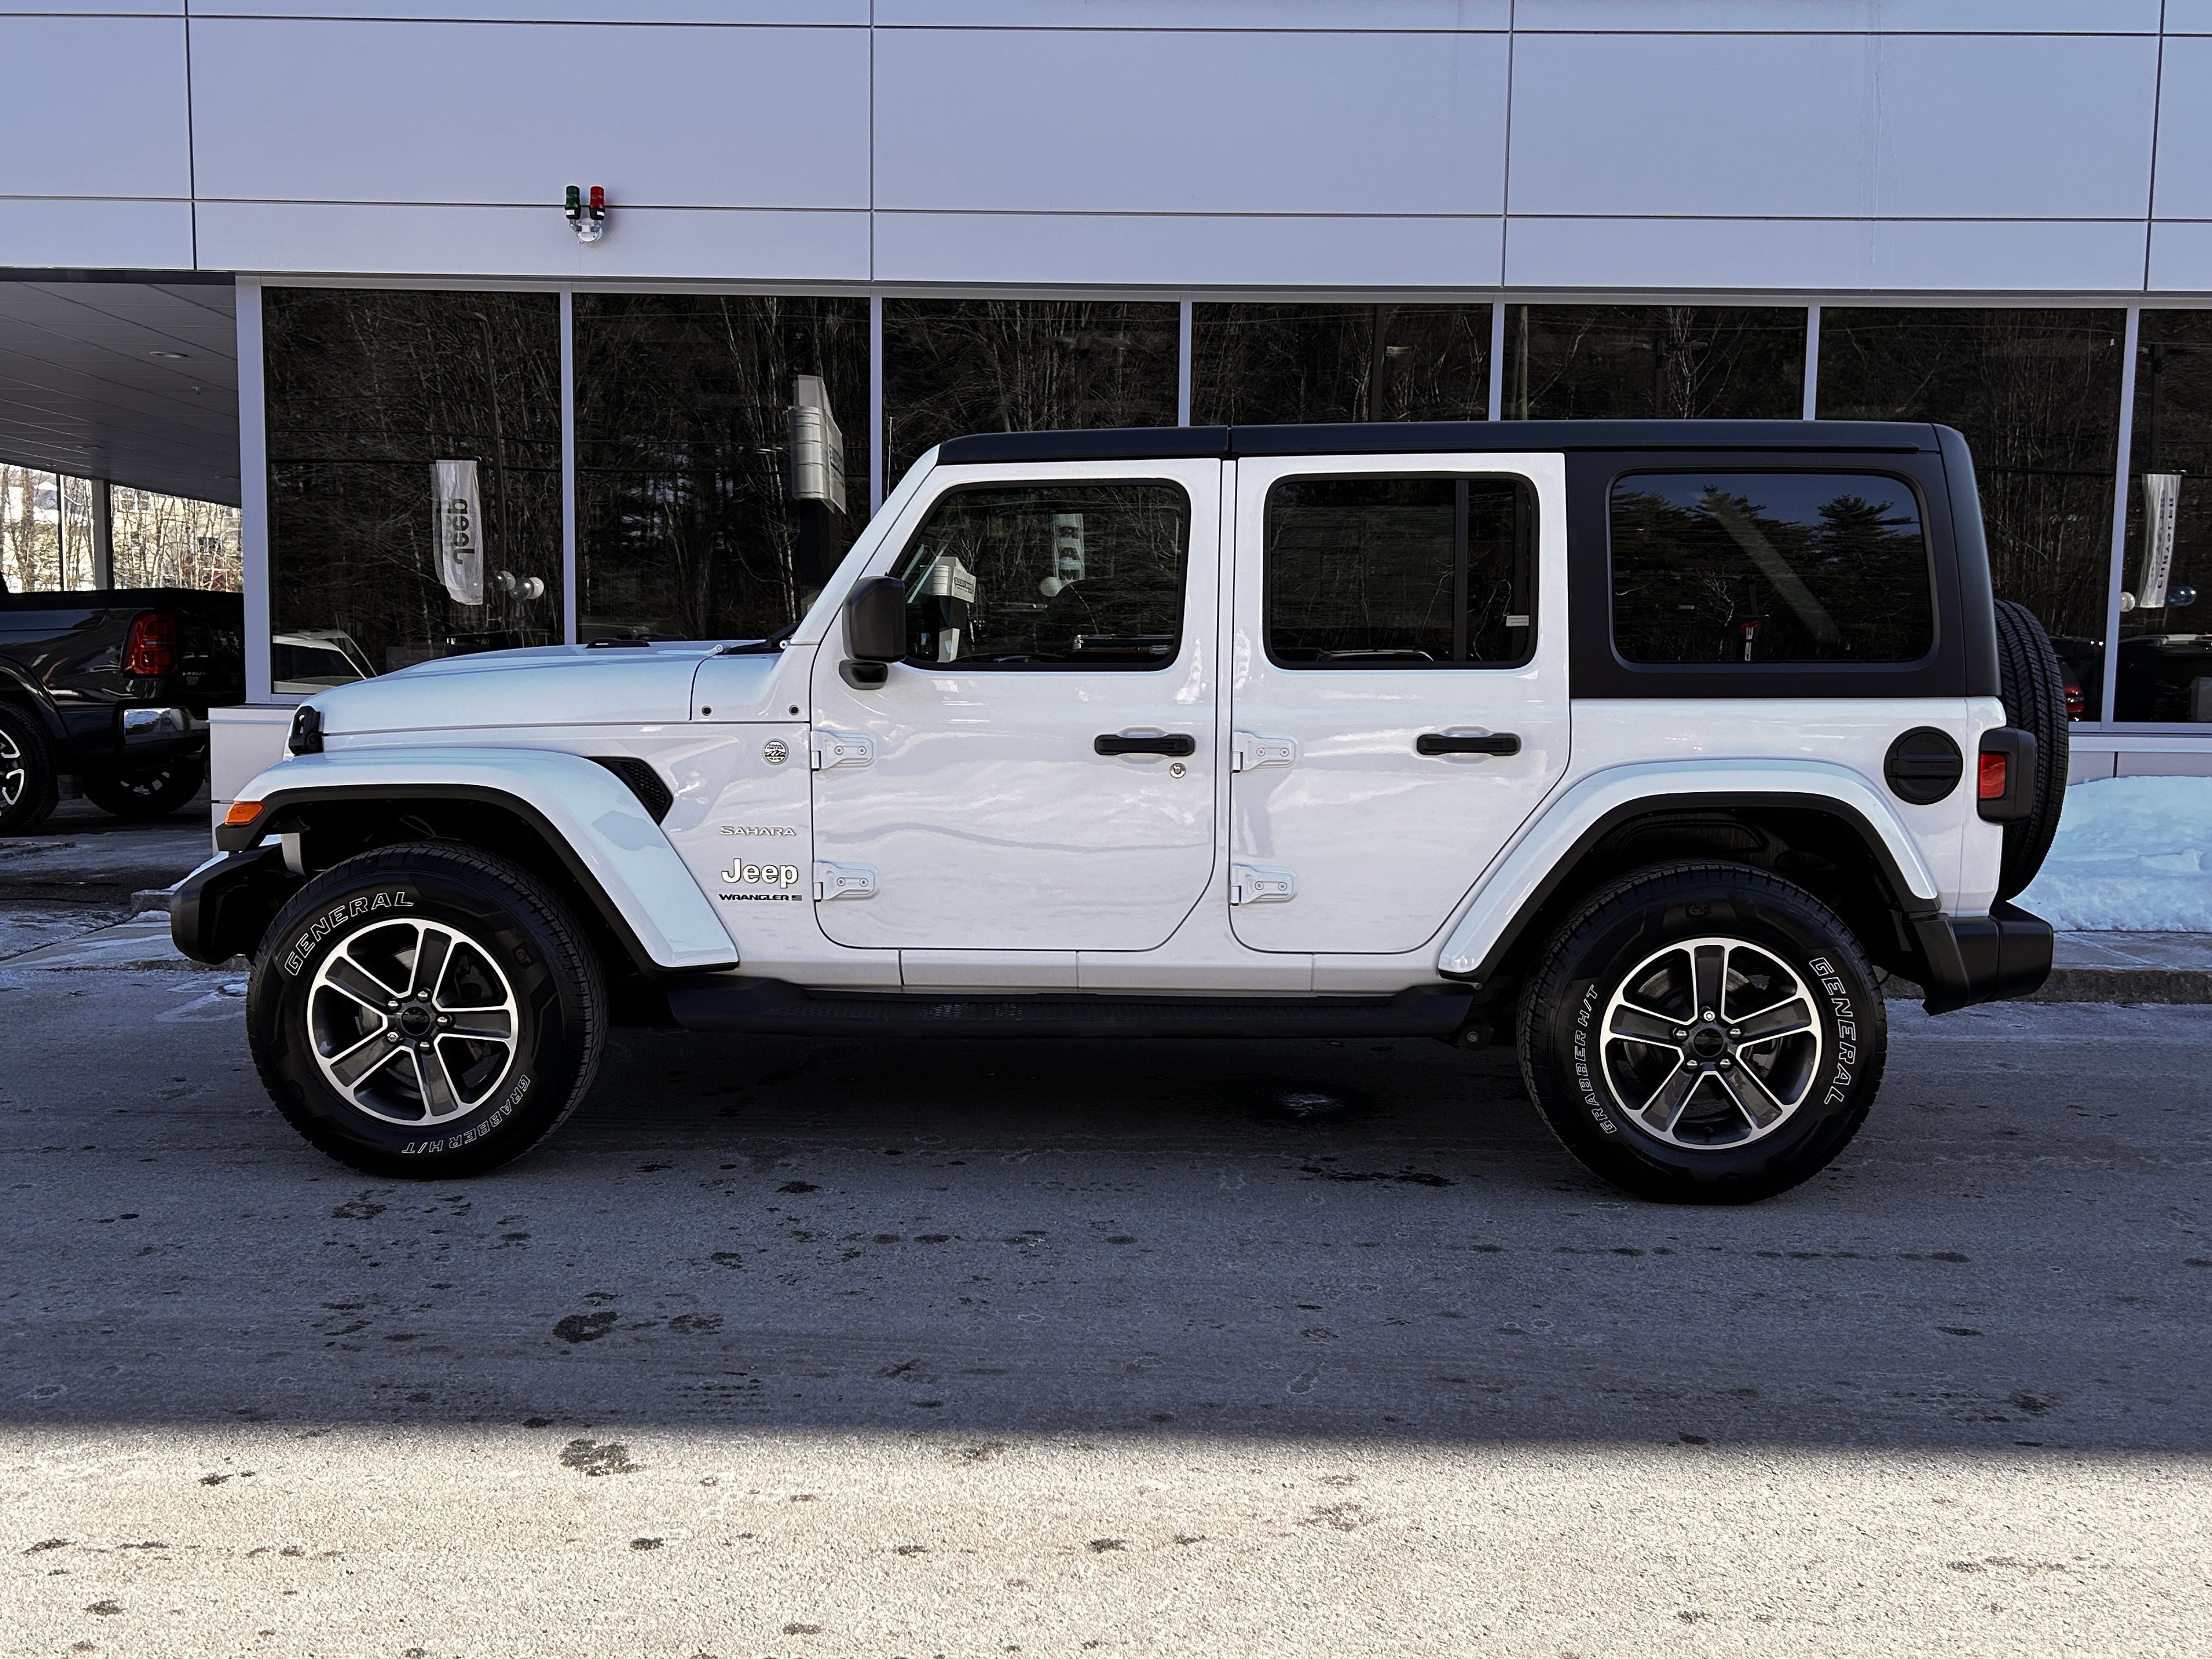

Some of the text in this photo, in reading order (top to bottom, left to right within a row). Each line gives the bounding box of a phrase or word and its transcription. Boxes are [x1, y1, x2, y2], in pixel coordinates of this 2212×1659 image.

[720, 826, 797, 836] SAHARA
[721, 858, 799, 889] Jeep
[284, 891, 414, 976] GENERAL
[1575, 984, 1617, 1134] GRABBER H/T
[1809, 957, 1857, 1105] GENERAL
[401, 1074, 531, 1154] GRABBER H/T
